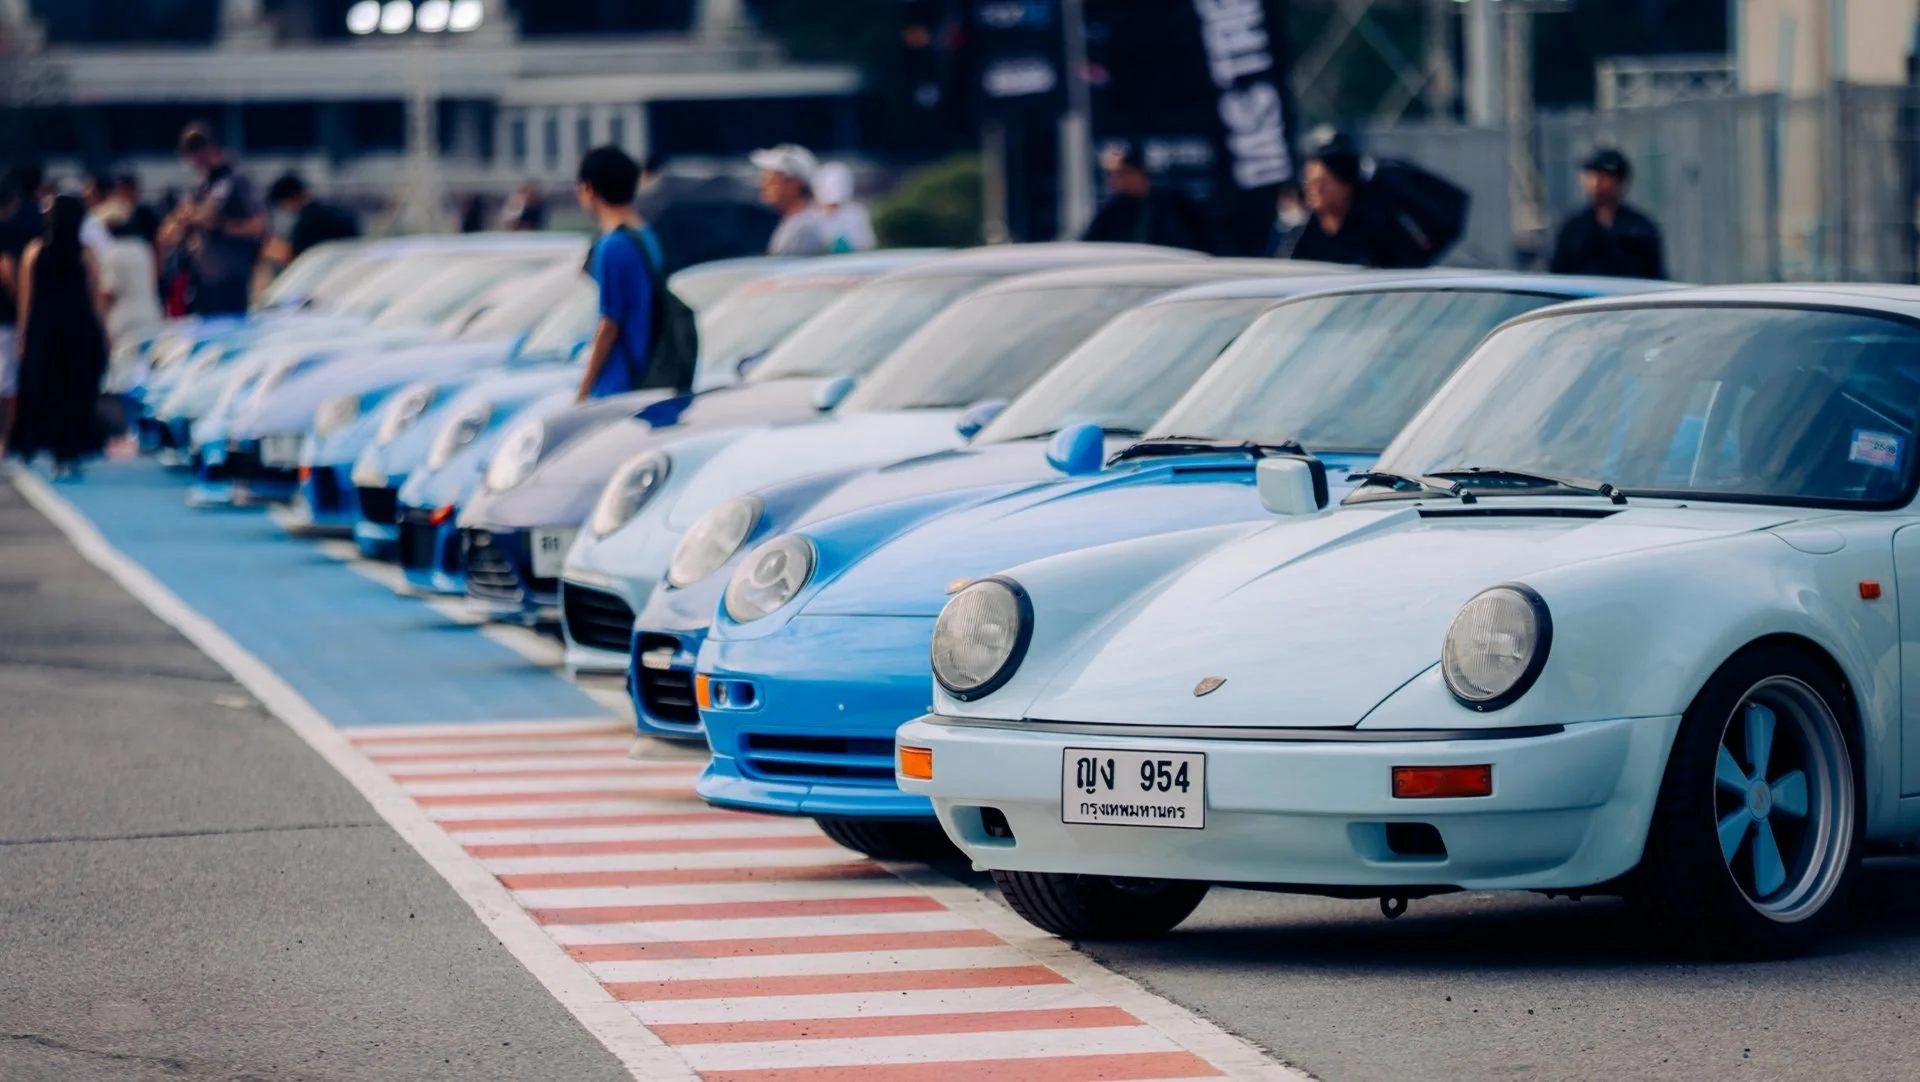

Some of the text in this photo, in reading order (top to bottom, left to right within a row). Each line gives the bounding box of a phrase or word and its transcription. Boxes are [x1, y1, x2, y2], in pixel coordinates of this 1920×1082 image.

[1218, 80, 1292, 189] DAS
[1076, 757, 1190, 794] ญง 954
[1080, 802, 1186, 820] กรุงเทพมหานคร
